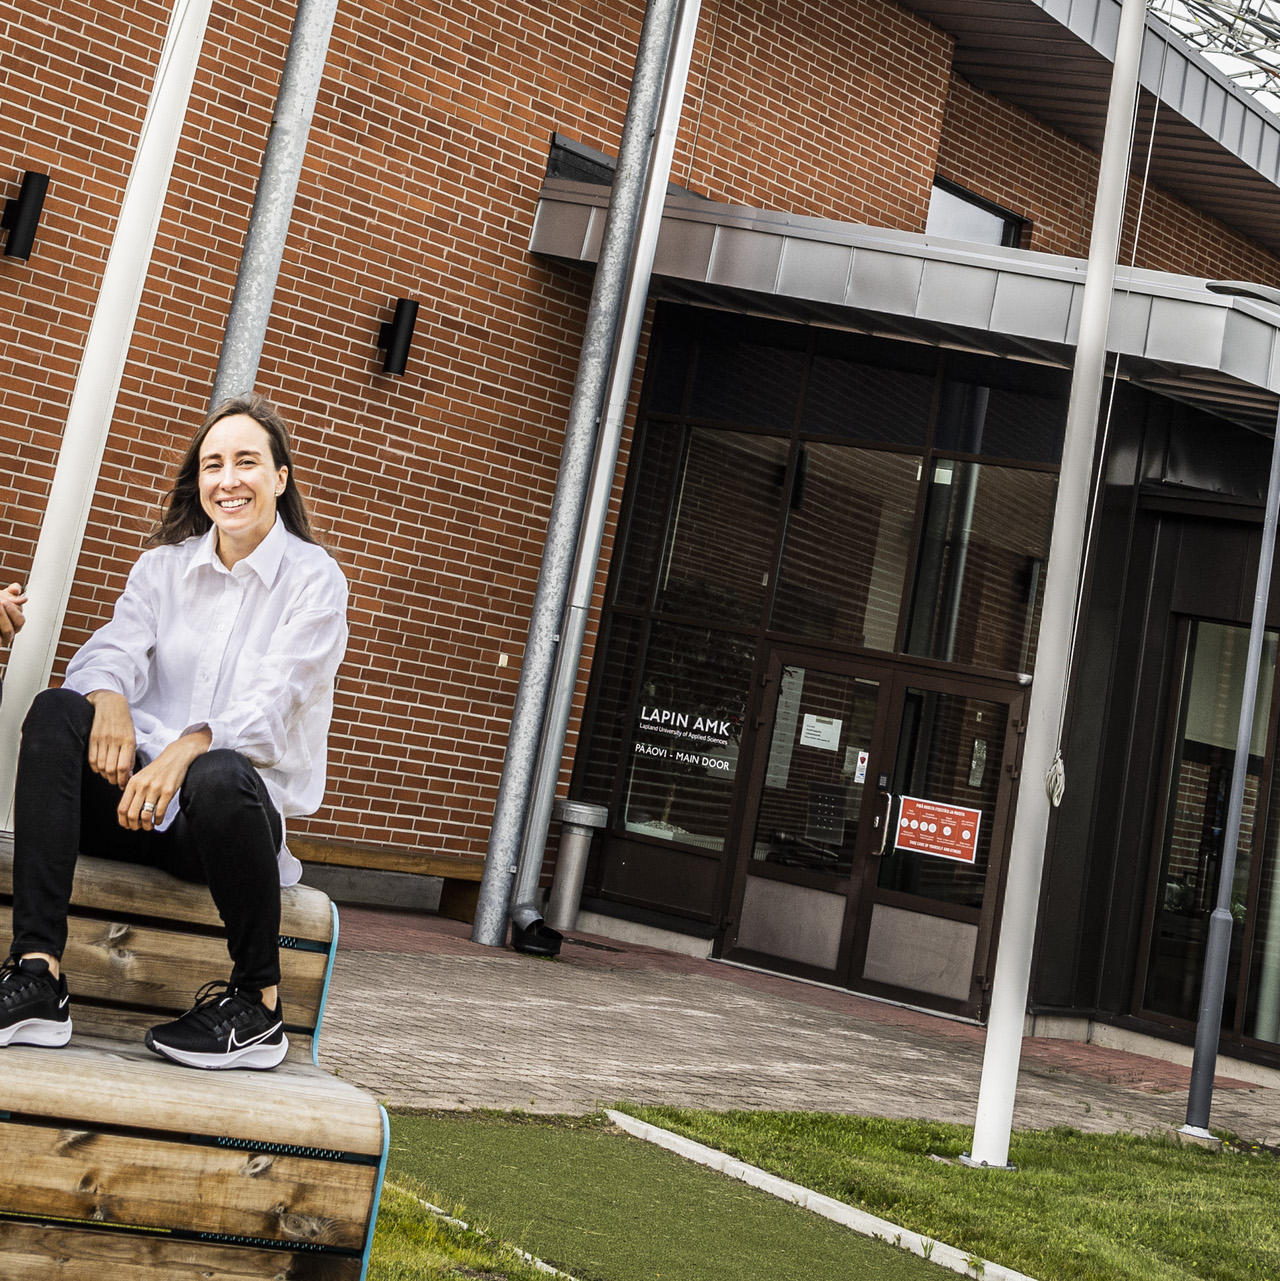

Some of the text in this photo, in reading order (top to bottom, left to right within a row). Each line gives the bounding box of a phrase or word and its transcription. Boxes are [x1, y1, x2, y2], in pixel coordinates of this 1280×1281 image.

[639, 722, 659, 732] Lapland
[658, 726, 682, 737] University
[688, 732, 707, 741] Applied
[706, 735, 728, 745] Sciences
[641, 706, 731, 737] LAPIN AMK
[635, 742, 667, 758] PÄÄOVI
[675, 752, 700, 765] MAIN
[701, 757, 730, 771] DOOR
